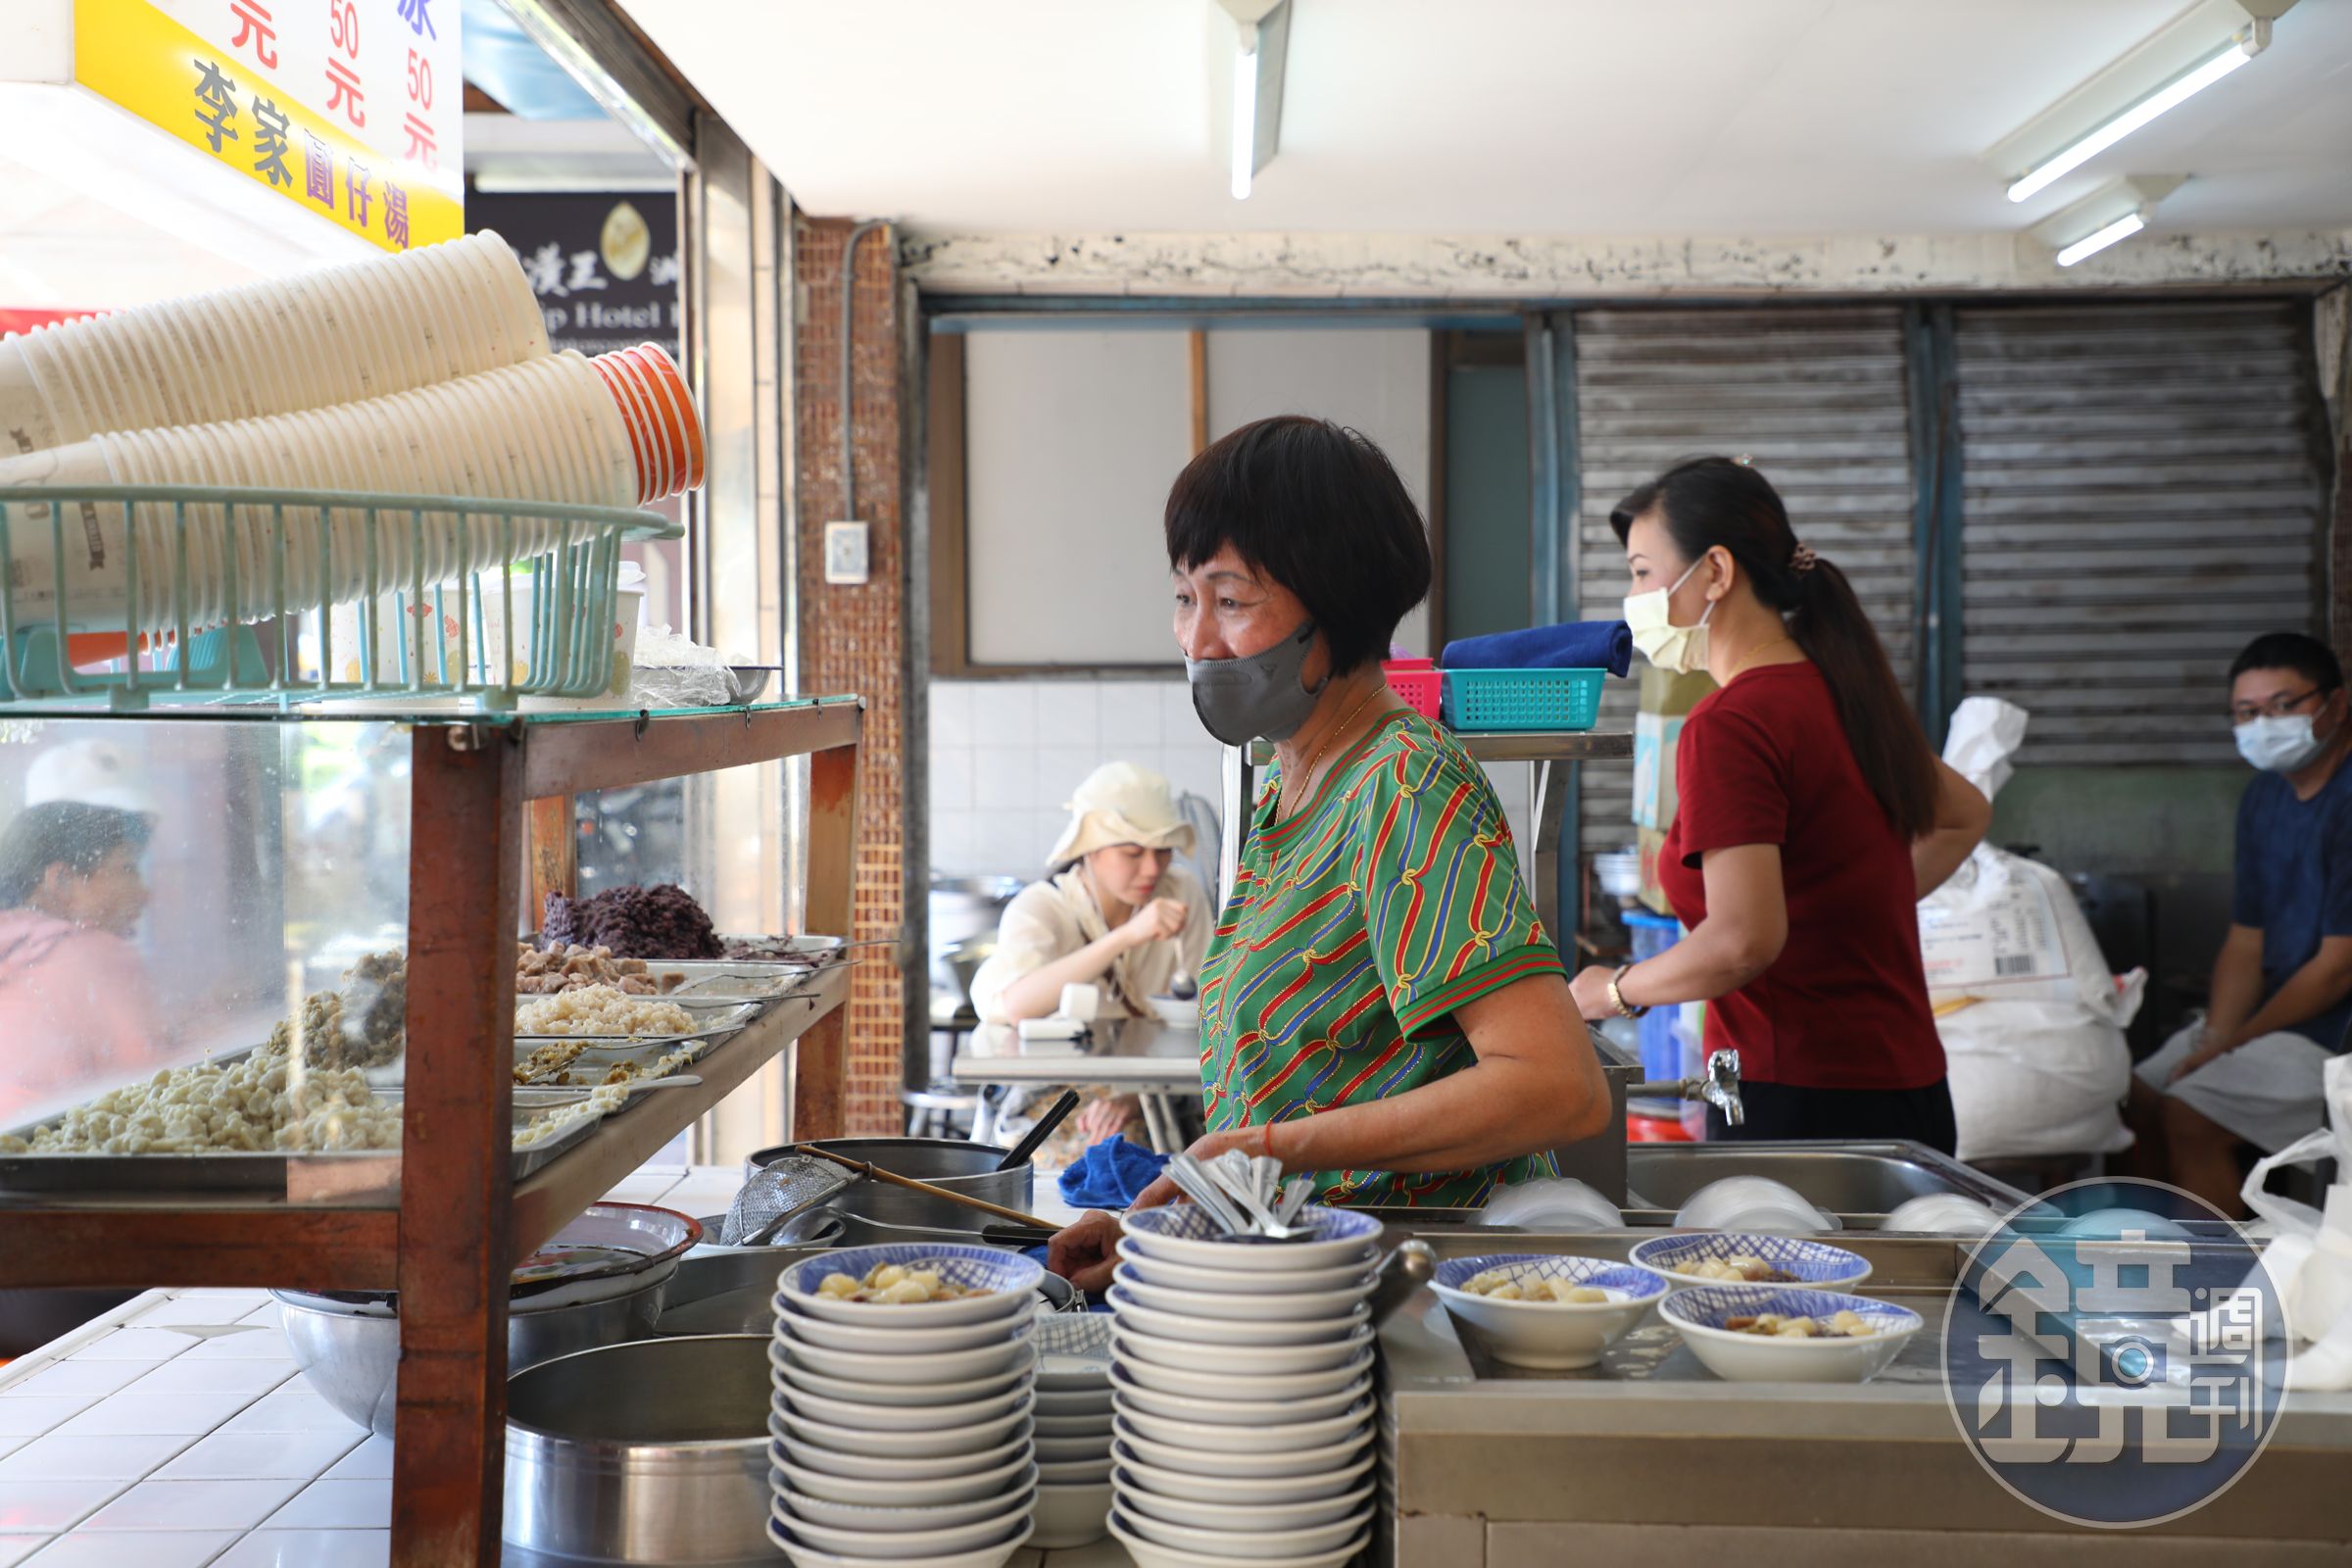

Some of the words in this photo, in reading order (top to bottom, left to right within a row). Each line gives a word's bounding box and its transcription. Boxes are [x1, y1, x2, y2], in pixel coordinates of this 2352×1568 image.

[194, 59, 409, 249] 李家圓仔湯
[575, 301, 661, 327] Hotel
